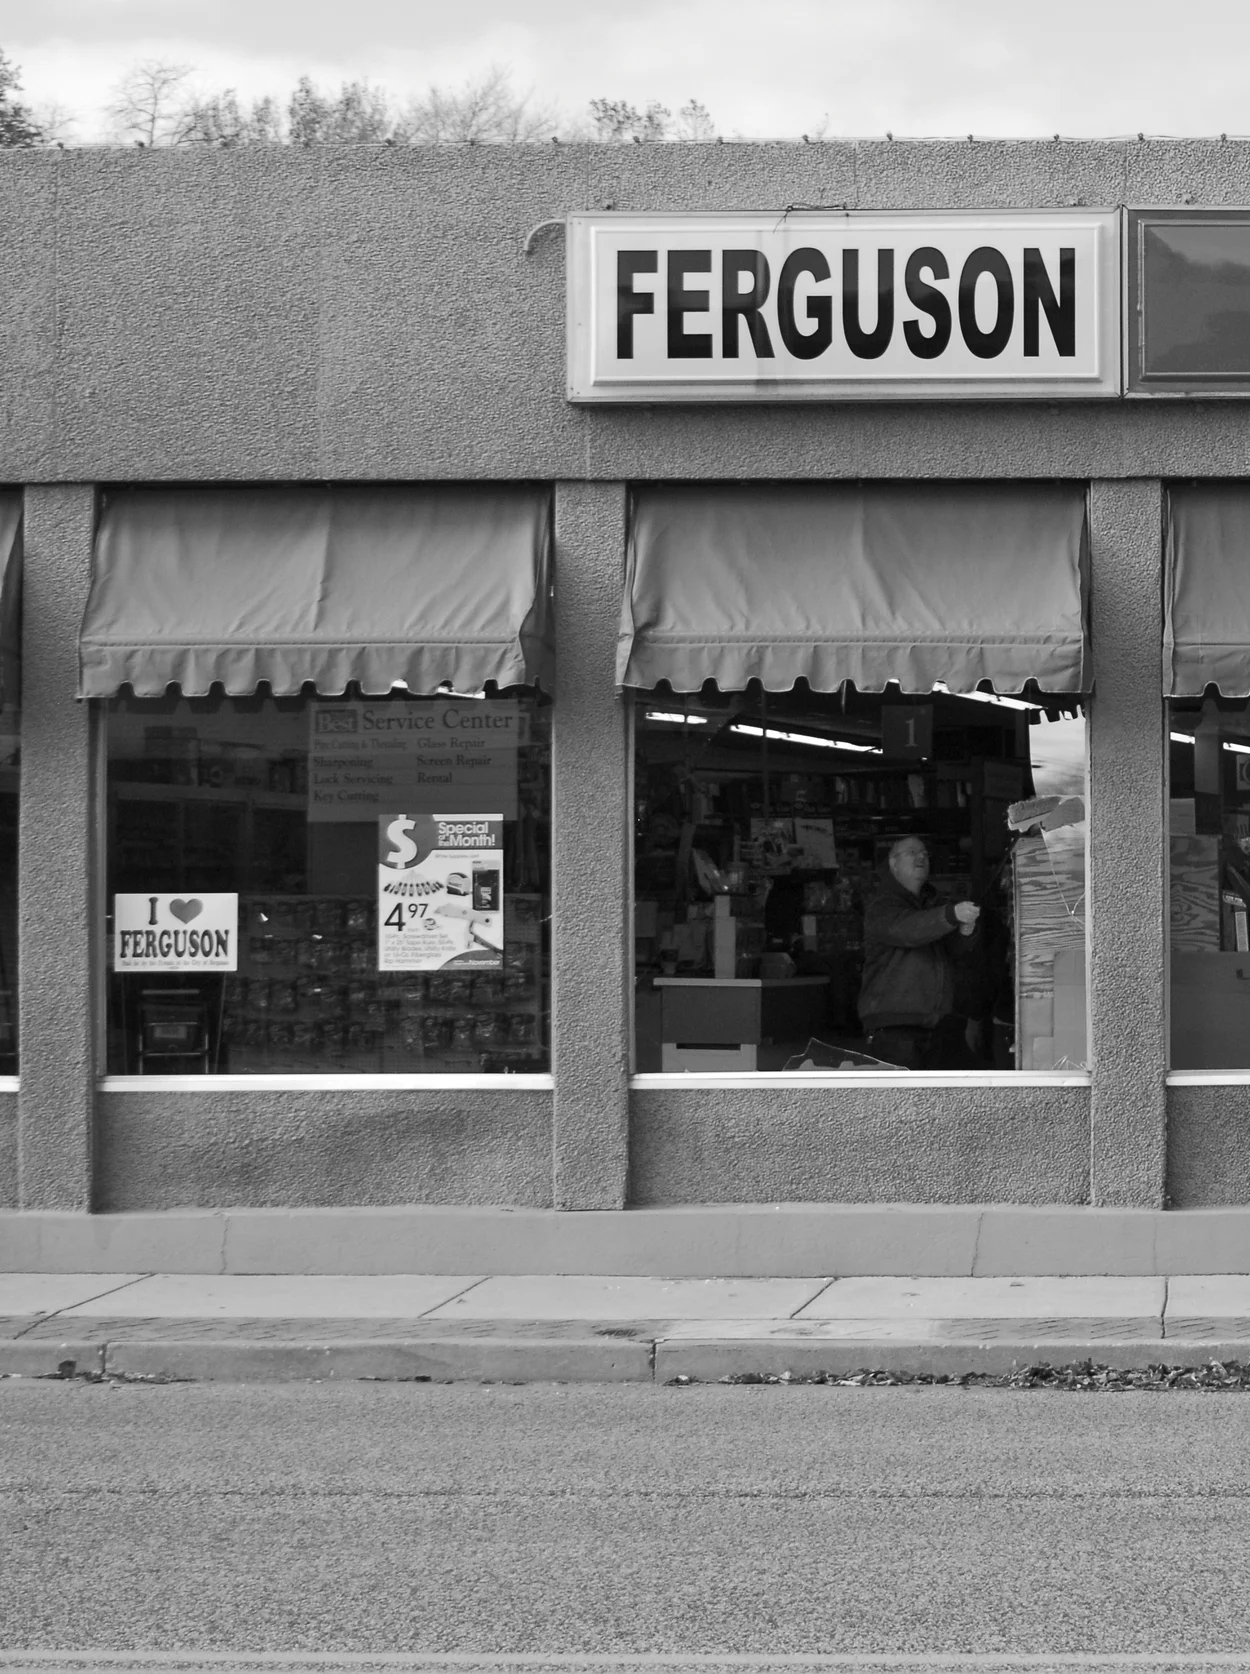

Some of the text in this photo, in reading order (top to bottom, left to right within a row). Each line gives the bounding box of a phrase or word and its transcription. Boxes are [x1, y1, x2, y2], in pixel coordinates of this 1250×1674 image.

[616, 246, 1077, 360] FERGUSON
[363, 710, 435, 730] Service
[443, 708, 513, 729] Center
[904, 718, 919, 748] 1
[417, 737, 485, 750] Glass Repair
[313, 756, 373, 769] Sharpening
[416, 754, 492, 768] Screen Repair
[314, 772, 394, 785] Lock Servicing
[417, 772, 453, 784] Rental
[313, 789, 379, 803] Key Cutting
[438, 822, 489, 836] Special
[387, 814, 418, 869] $
[449, 834, 496, 847] Month!
[148, 896, 159, 926] I
[120, 929, 230, 958] FERGUSON
